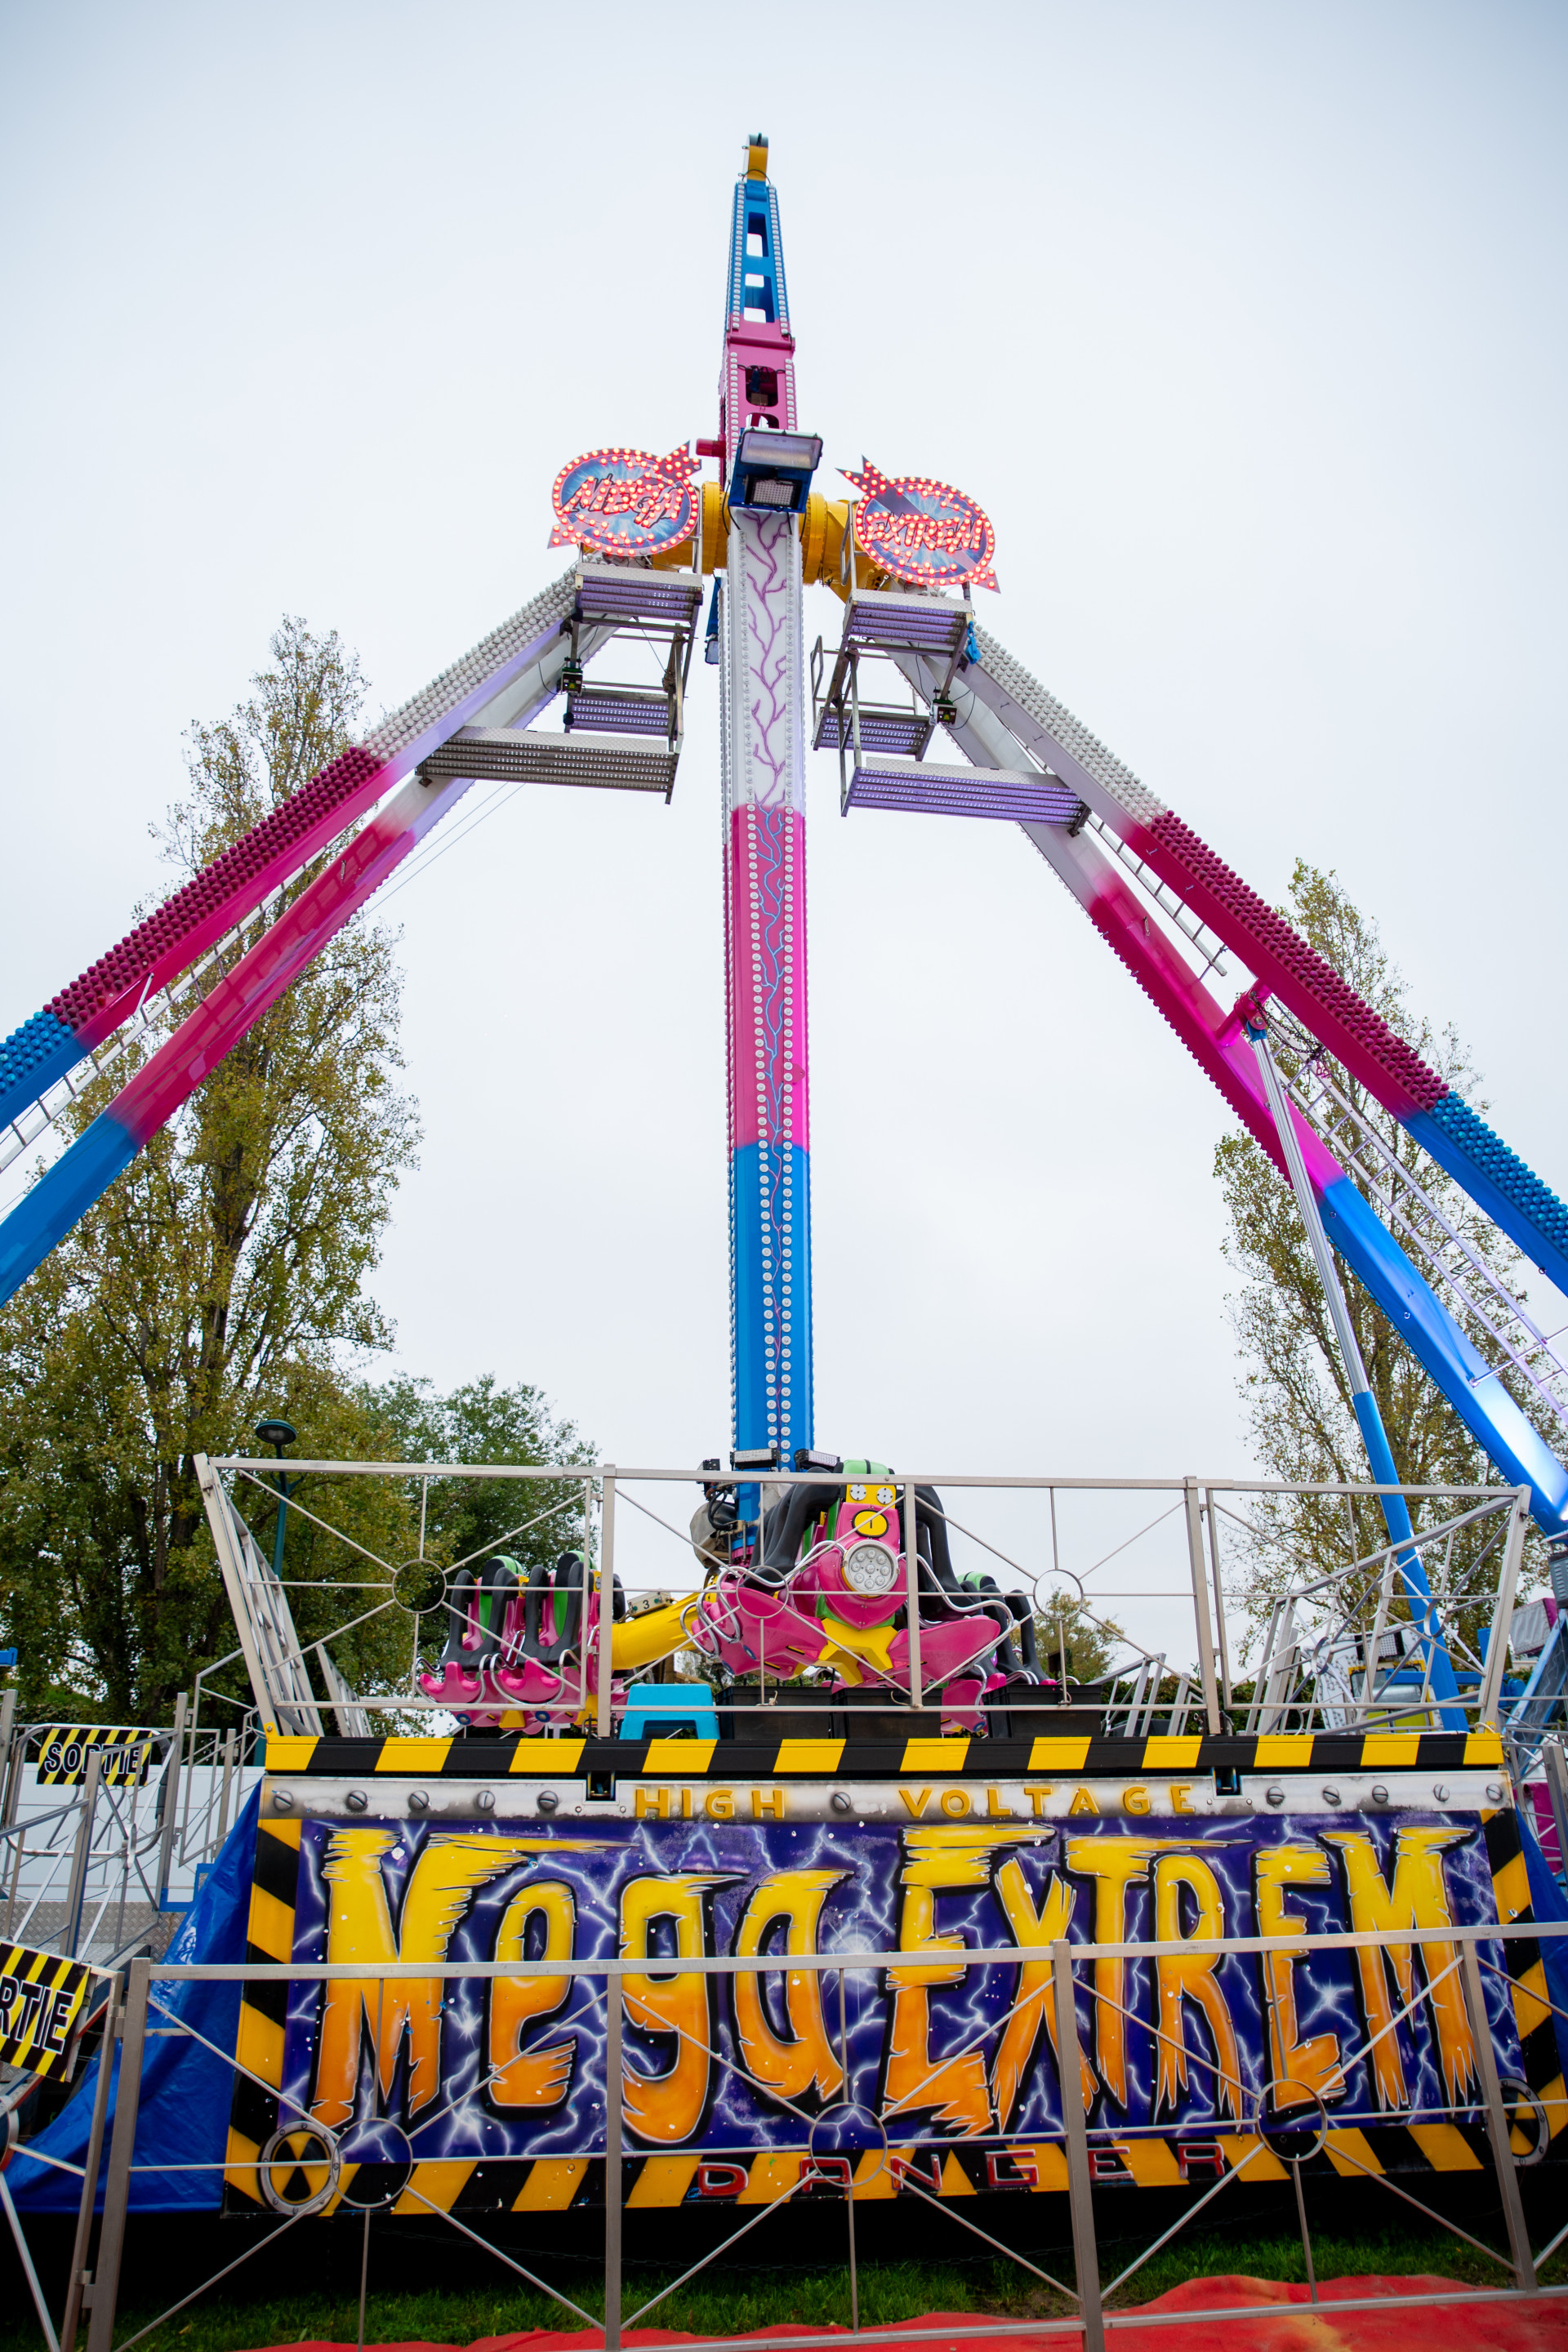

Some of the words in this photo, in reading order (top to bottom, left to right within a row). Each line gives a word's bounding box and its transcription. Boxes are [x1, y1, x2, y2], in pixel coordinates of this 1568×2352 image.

[864, 511, 984, 551] EXTREM
[643, 1600, 650, 1610] 3
[635, 1787, 786, 1819] HIGH
[898, 1784, 1195, 1819] VOLTAGE
[698, 2142, 1225, 2197] DANGER
